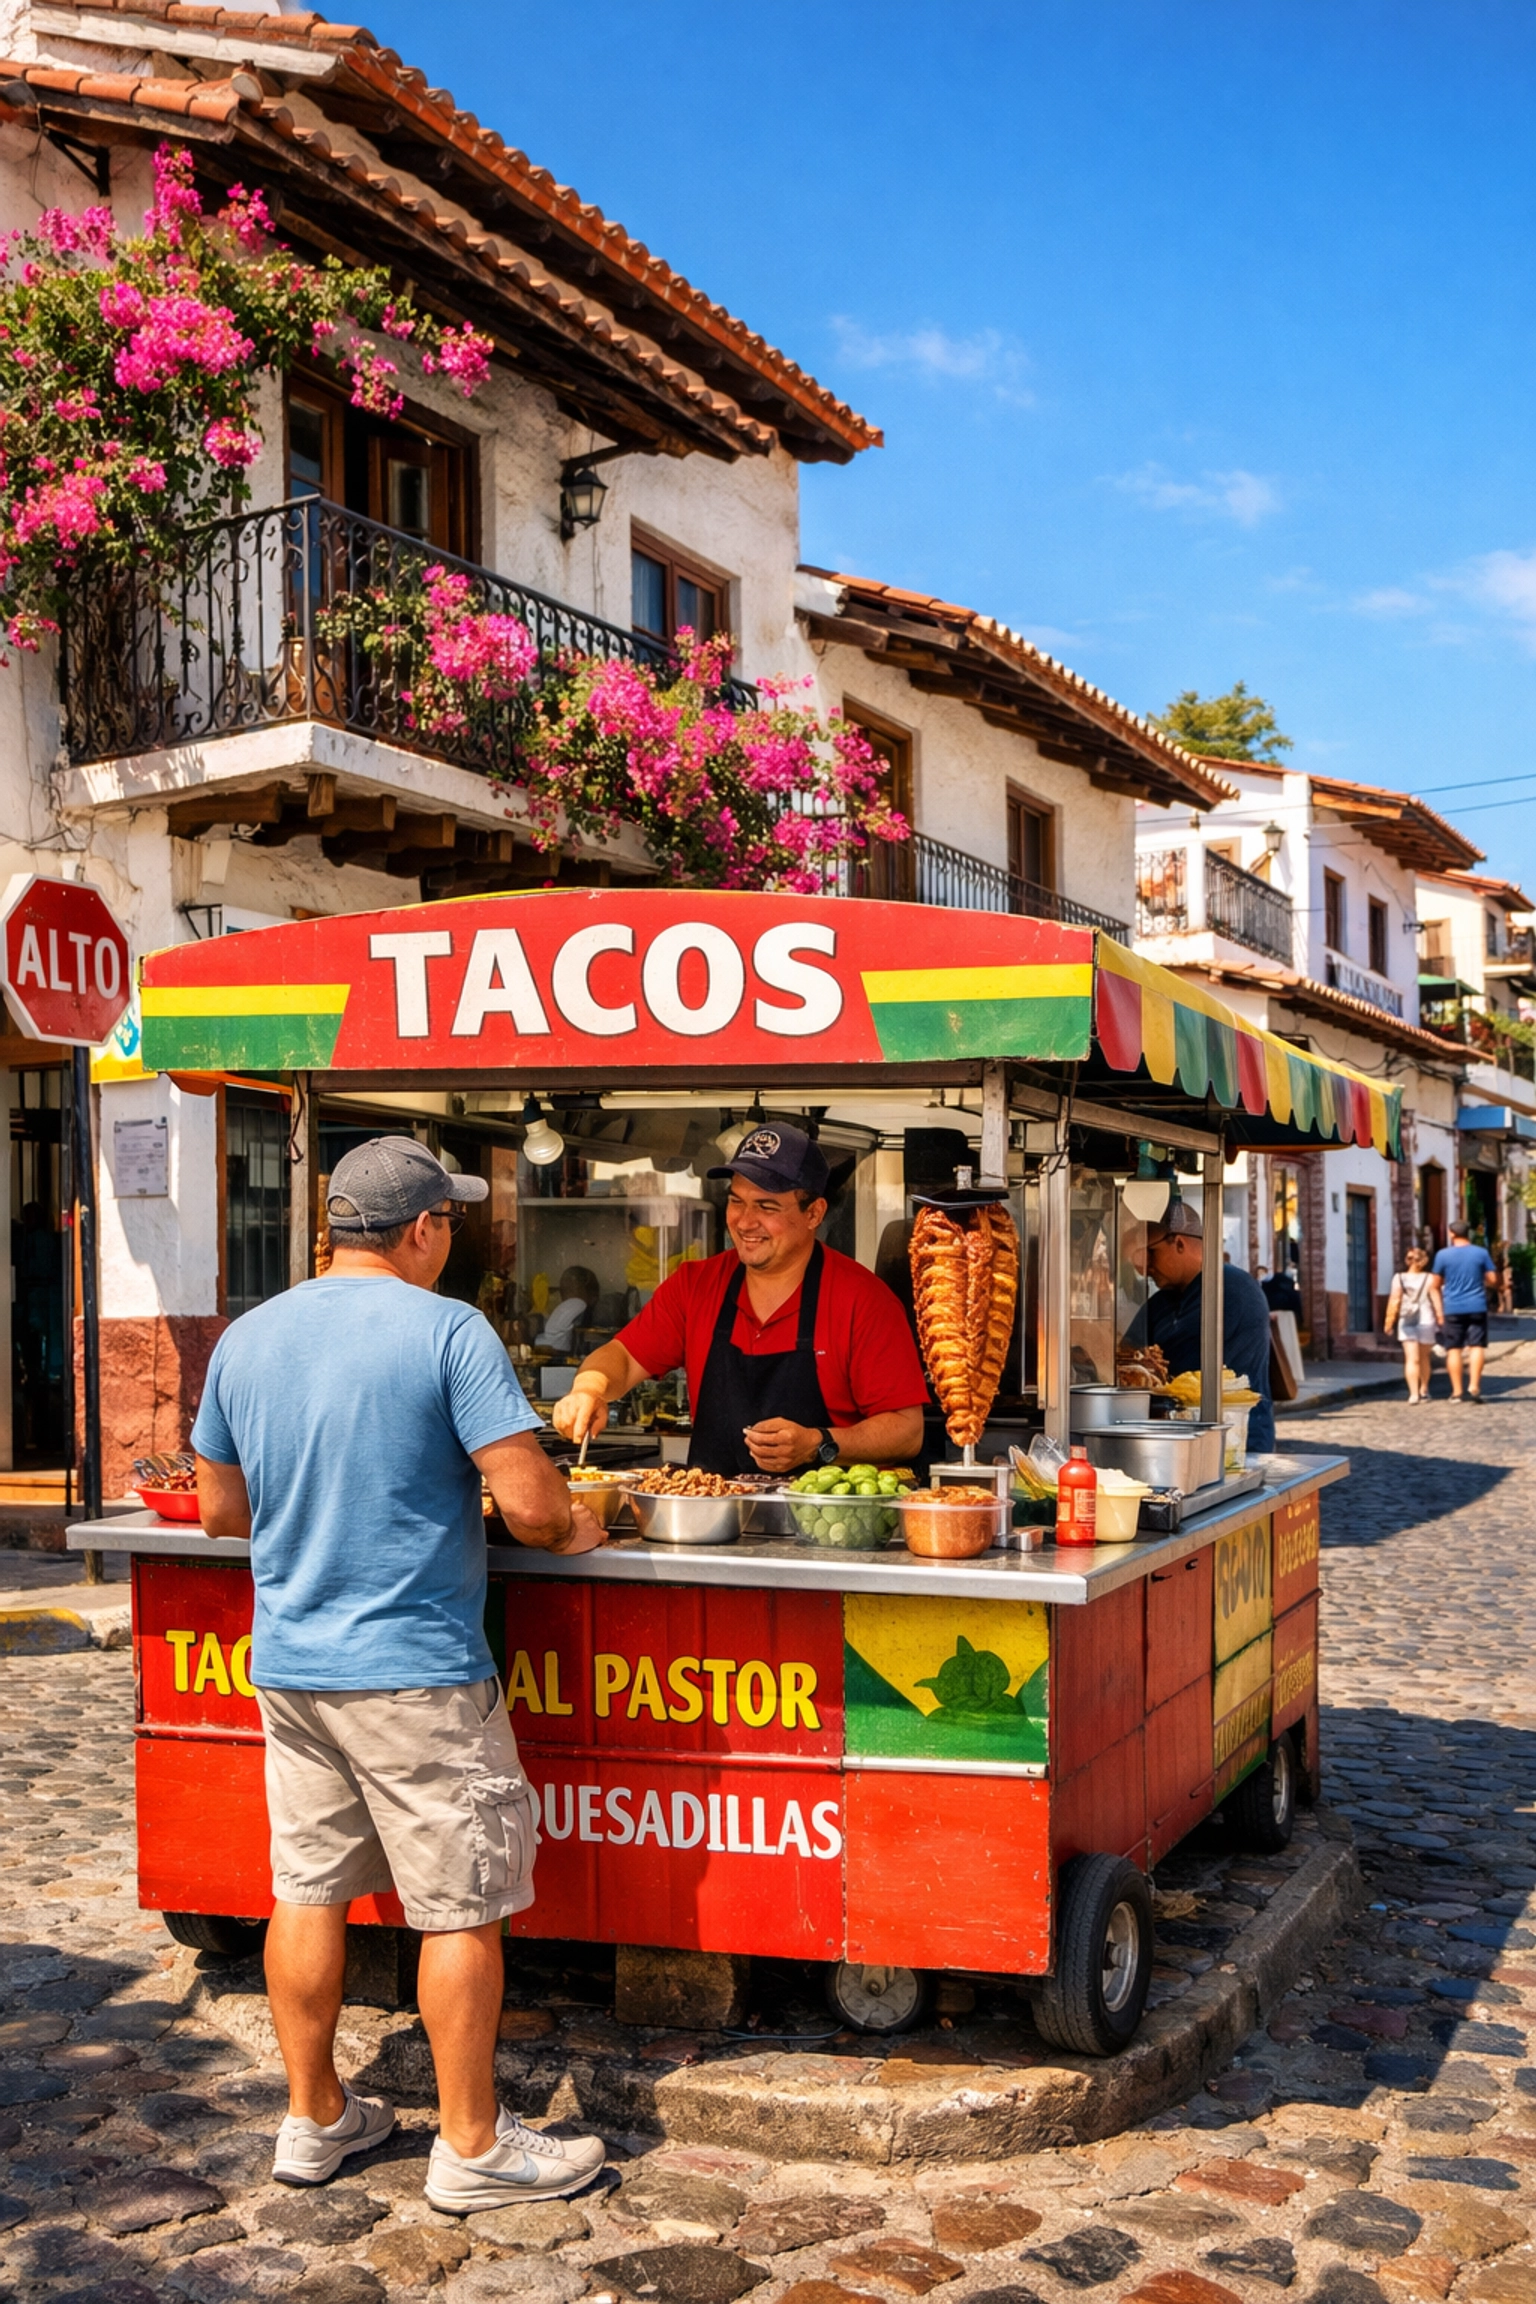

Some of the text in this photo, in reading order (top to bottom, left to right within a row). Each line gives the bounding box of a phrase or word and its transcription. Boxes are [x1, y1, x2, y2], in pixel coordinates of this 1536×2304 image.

[17, 924, 120, 999] ALTO
[369, 922, 843, 1036] TACOS
[165, 1630, 821, 1730] TAC AL PASTOR
